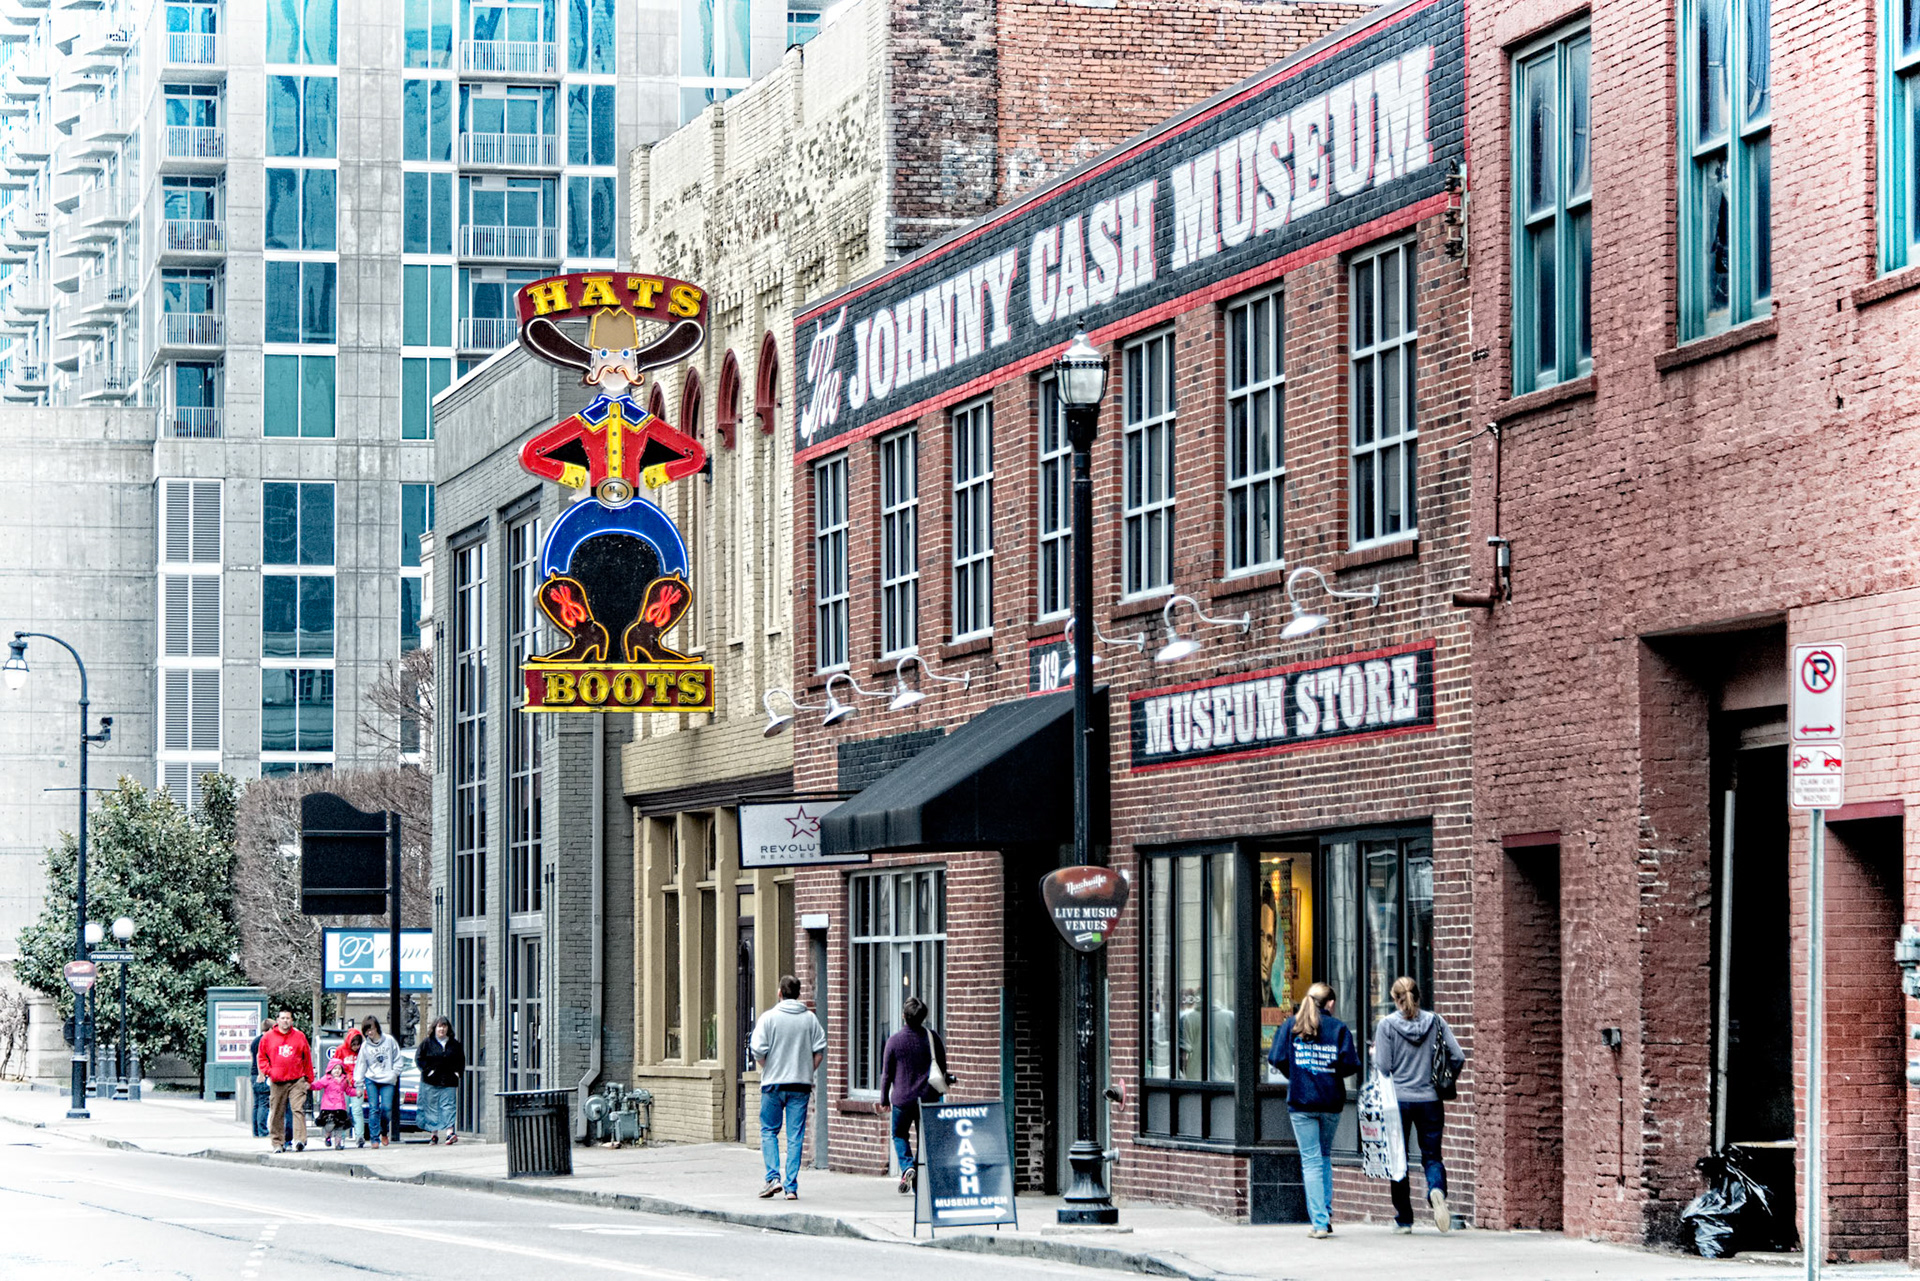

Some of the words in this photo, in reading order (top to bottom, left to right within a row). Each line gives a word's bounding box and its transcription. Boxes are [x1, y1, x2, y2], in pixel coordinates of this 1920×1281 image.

[800, 305, 847, 446] The
[848, 247, 1016, 410] JOHNNY
[1029, 178, 1157, 325] CASH
[1171, 44, 1433, 271] MUSEUM
[527, 276, 703, 318] HATS
[1039, 650, 1060, 691] 119
[542, 671, 707, 706] BOOTS
[1145, 676, 1287, 756] MUSEUM
[1294, 655, 1419, 737] STORE
[760, 843, 820, 853] REVOLU
[1065, 875, 1107, 895] Nashville
[1055, 907, 1080, 918] LIVE
[1082, 907, 1118, 918] MUSIC
[1065, 920, 1108, 931] VENUES
[339, 936, 431, 967] Prmi
[333, 973, 432, 984] PARIN
[937, 1107, 988, 1119] JOHNNY
[955, 1118, 979, 1195] CASH
[935, 1198, 978, 1208] MUSEUM
[981, 1196, 1008, 1206] OPEN
